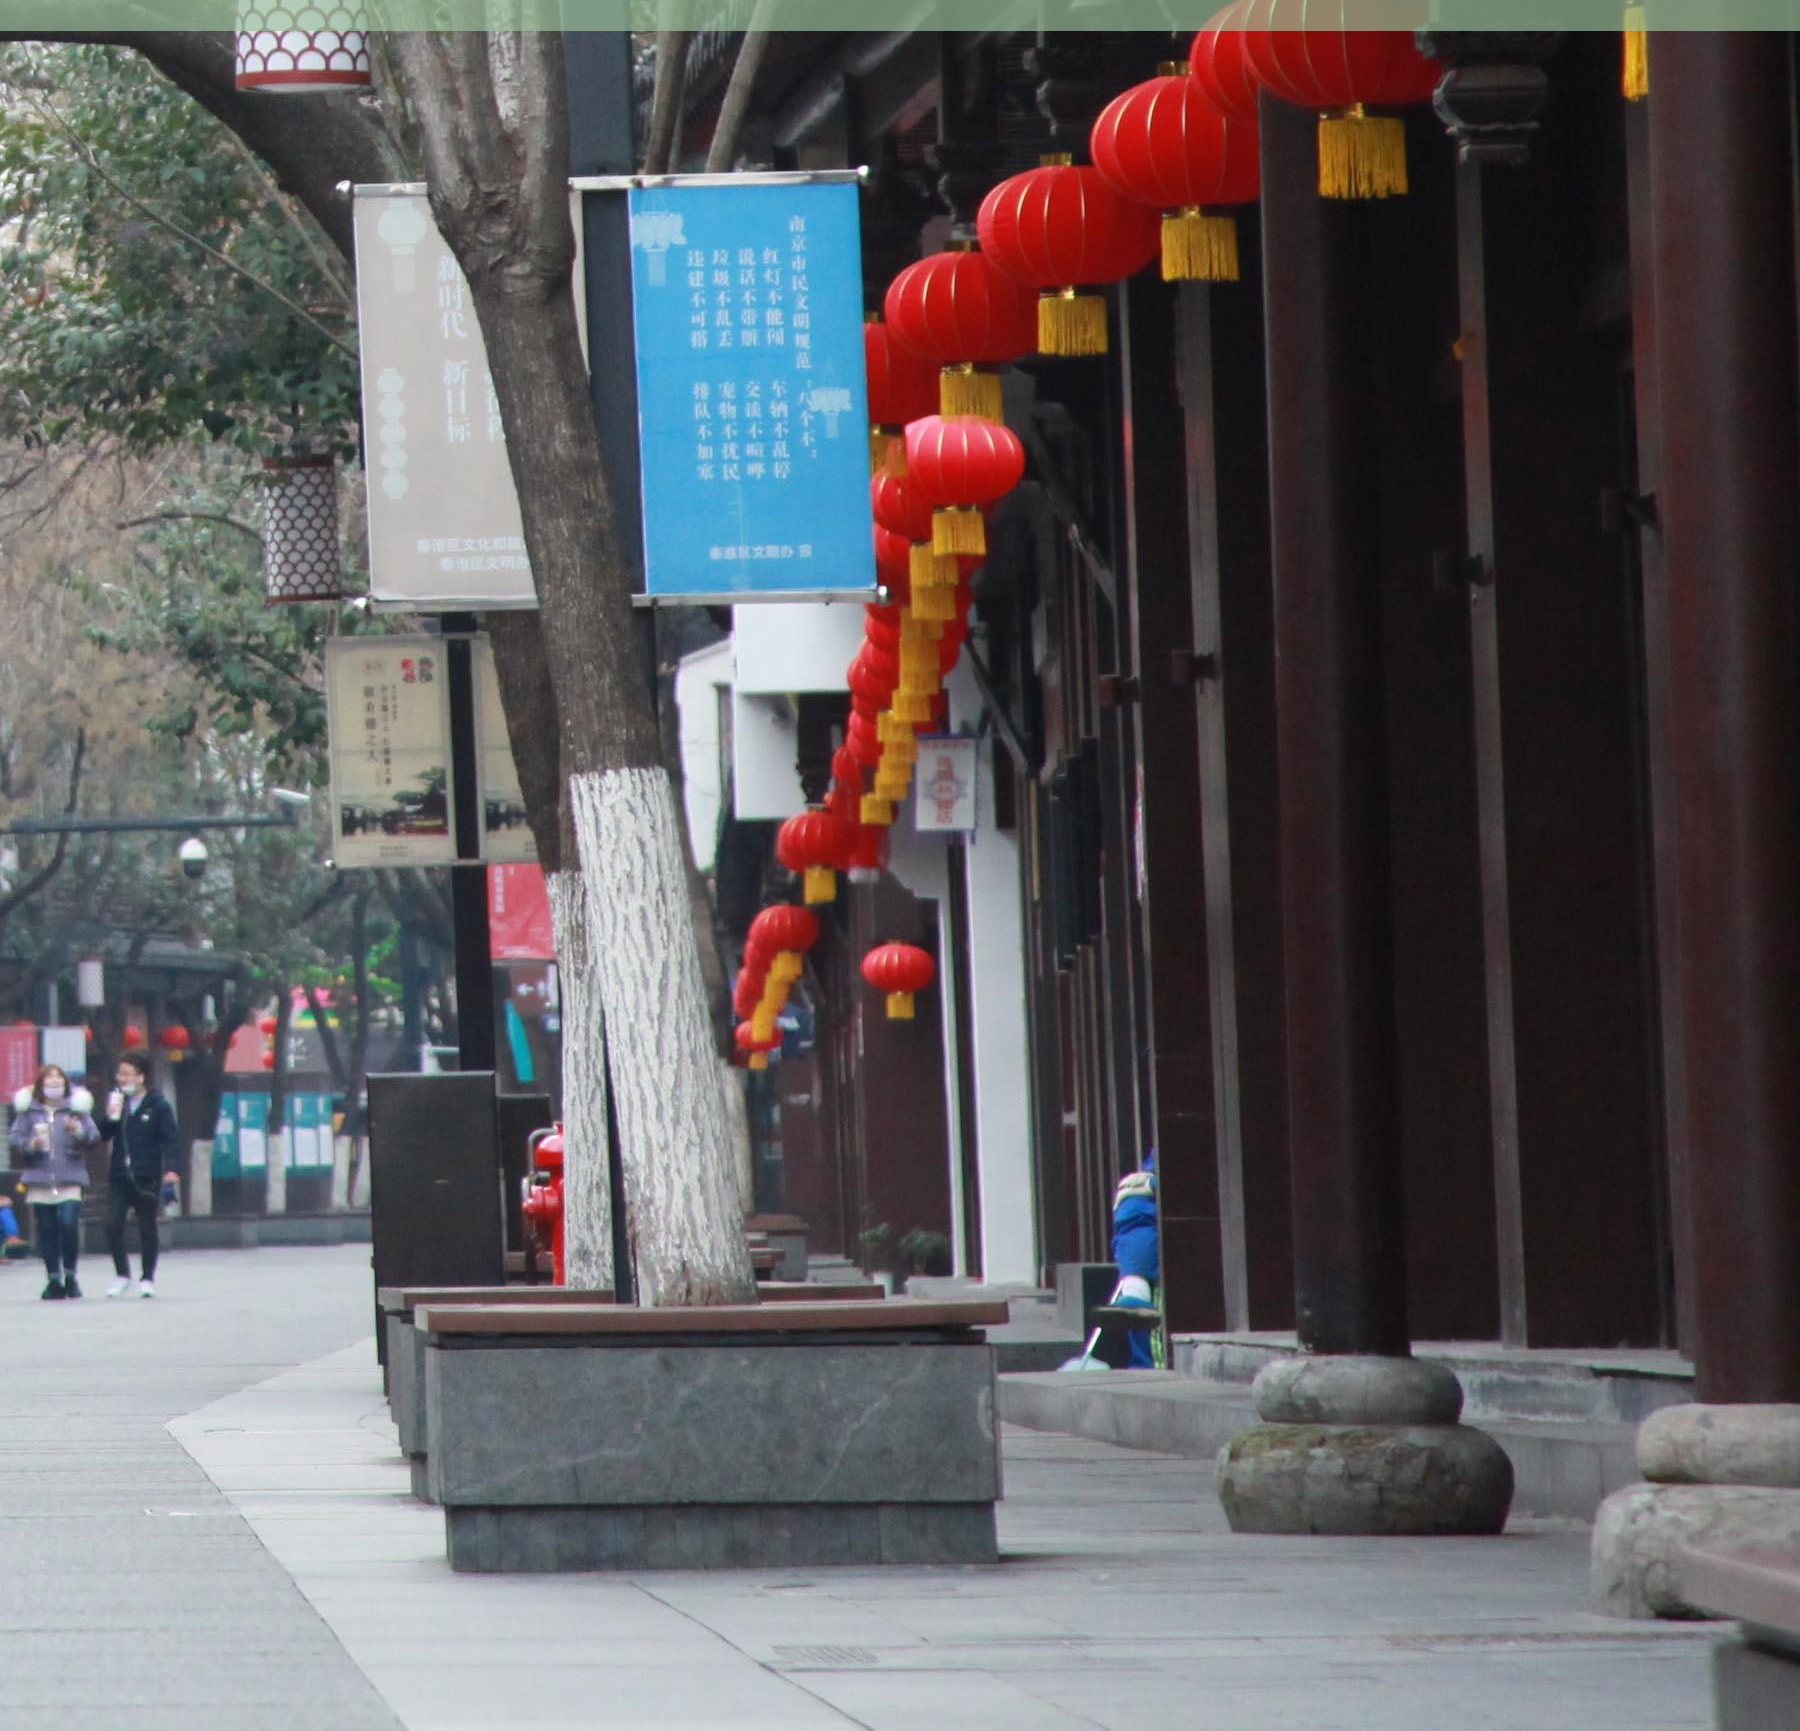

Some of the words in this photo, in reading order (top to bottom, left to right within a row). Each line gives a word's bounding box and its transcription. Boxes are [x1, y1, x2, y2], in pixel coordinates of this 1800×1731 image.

[438, 255, 467, 340] 新时代
[738, 247, 760, 347] 说话不带脏
[762, 247, 785, 347] 红灯不能闯
[443, 360, 471, 443] 新目标
